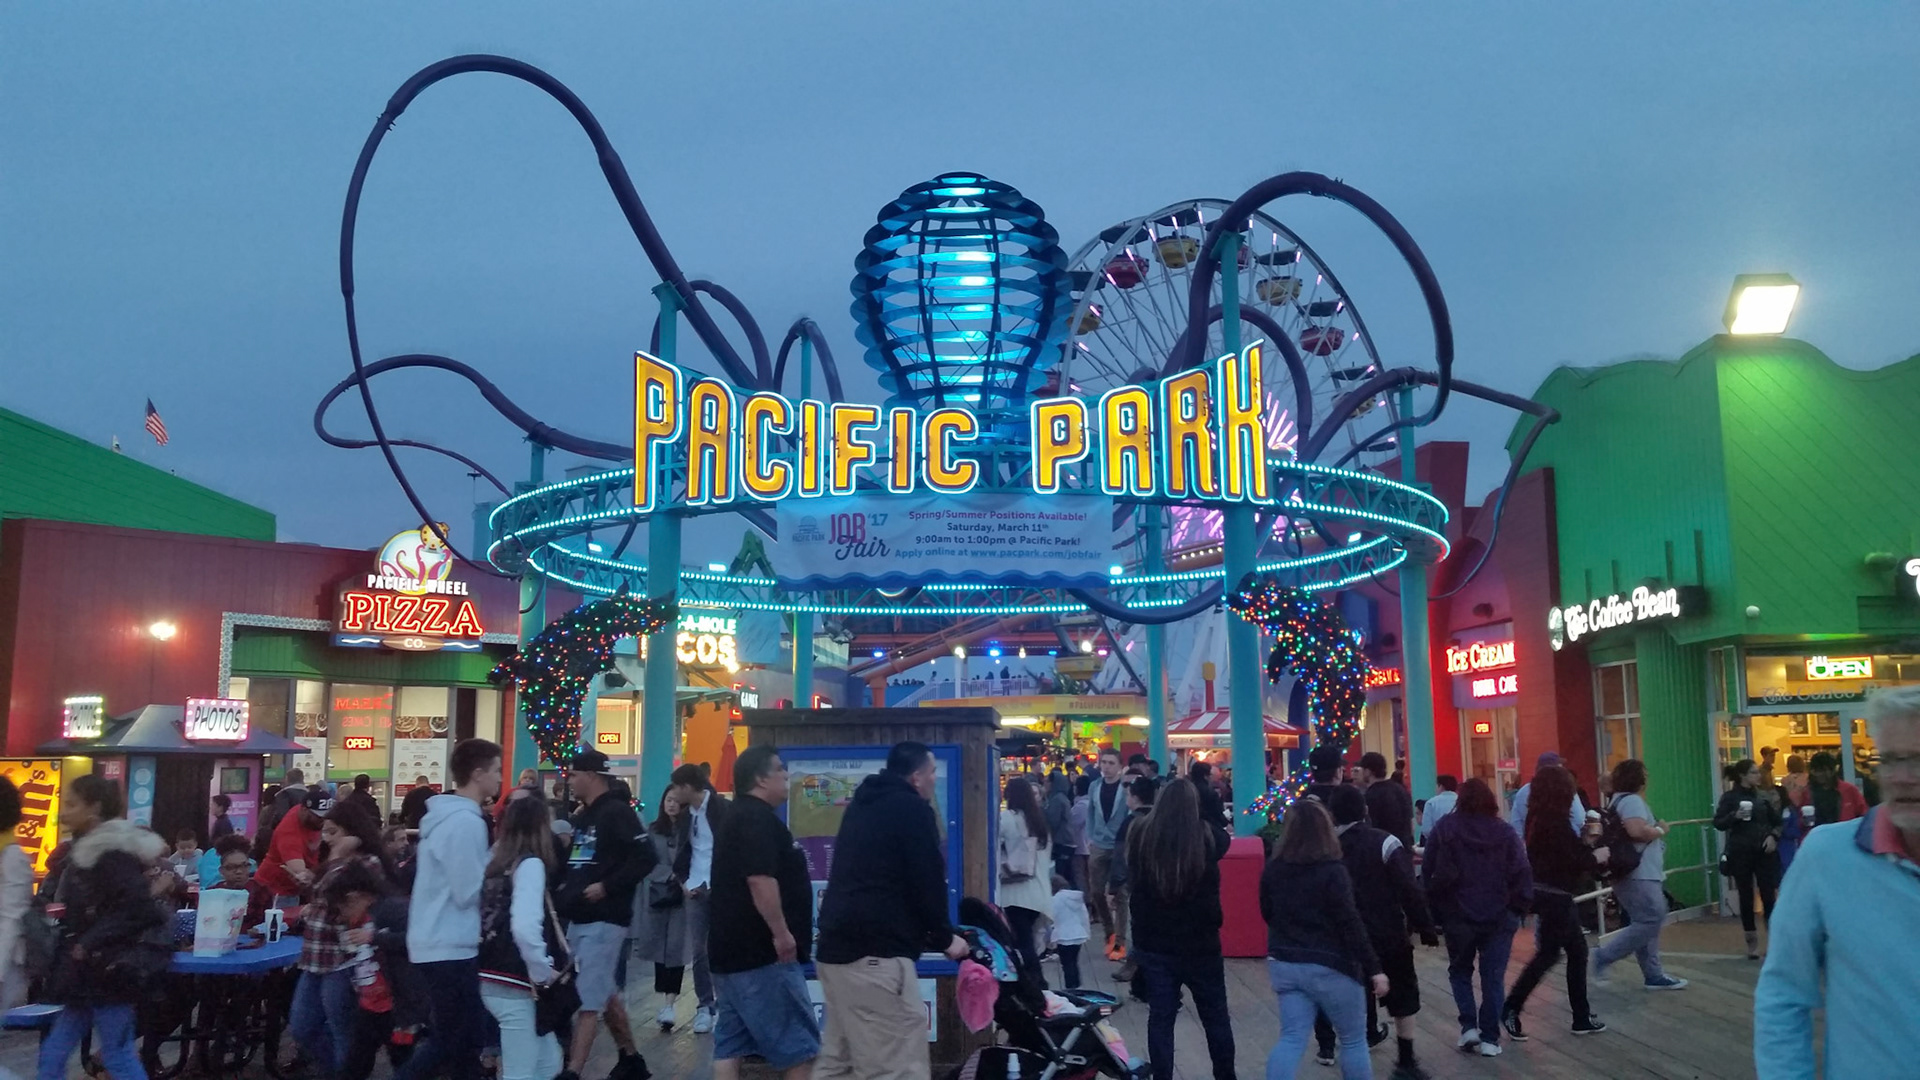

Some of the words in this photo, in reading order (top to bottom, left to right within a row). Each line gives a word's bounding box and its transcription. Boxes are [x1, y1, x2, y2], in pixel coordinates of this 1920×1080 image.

[634, 351, 979, 512] PACIFIC
[1030, 338, 1274, 503] PARK
[909, 510, 988, 521] Spring/Summer
[990, 511, 1036, 520] Positions
[1038, 511, 1087, 521] Available!
[828, 513, 866, 544] JOB
[947, 522, 995, 532] Saturday,
[998, 523, 1029, 532] March
[835, 535, 890, 560] Fair
[915, 535, 951, 545] 9:00am
[954, 536, 965, 544] to
[967, 536, 1005, 546] 1:00pm
[1008, 537, 1019, 545] @
[1020, 536, 1052, 545] Pacific
[1055, 537, 1080, 546] Park!
[895, 549, 922, 558] Apply
[925, 547, 956, 556] online
[367, 574, 420, 591] PACIFIC
[426, 579, 468, 595] WHEEL
[343, 592, 484, 636] PIZZA
[1564, 604, 1588, 642] The
[1589, 594, 1633, 632] Coffee
[1632, 586, 1681, 621] Bean
[404, 638, 426, 648] CO.
[1446, 648, 1469, 672] ICE
[1470, 642, 1515, 668] CREAM
[1808, 657, 1871, 679] OPEN
[1762, 686, 1793, 704] The
[1797, 686, 1855, 701] Coffee
[192, 706, 242, 733] PHOTOS
[346, 738, 371, 748] OPEN
[600, 734, 619, 743] OPEN
